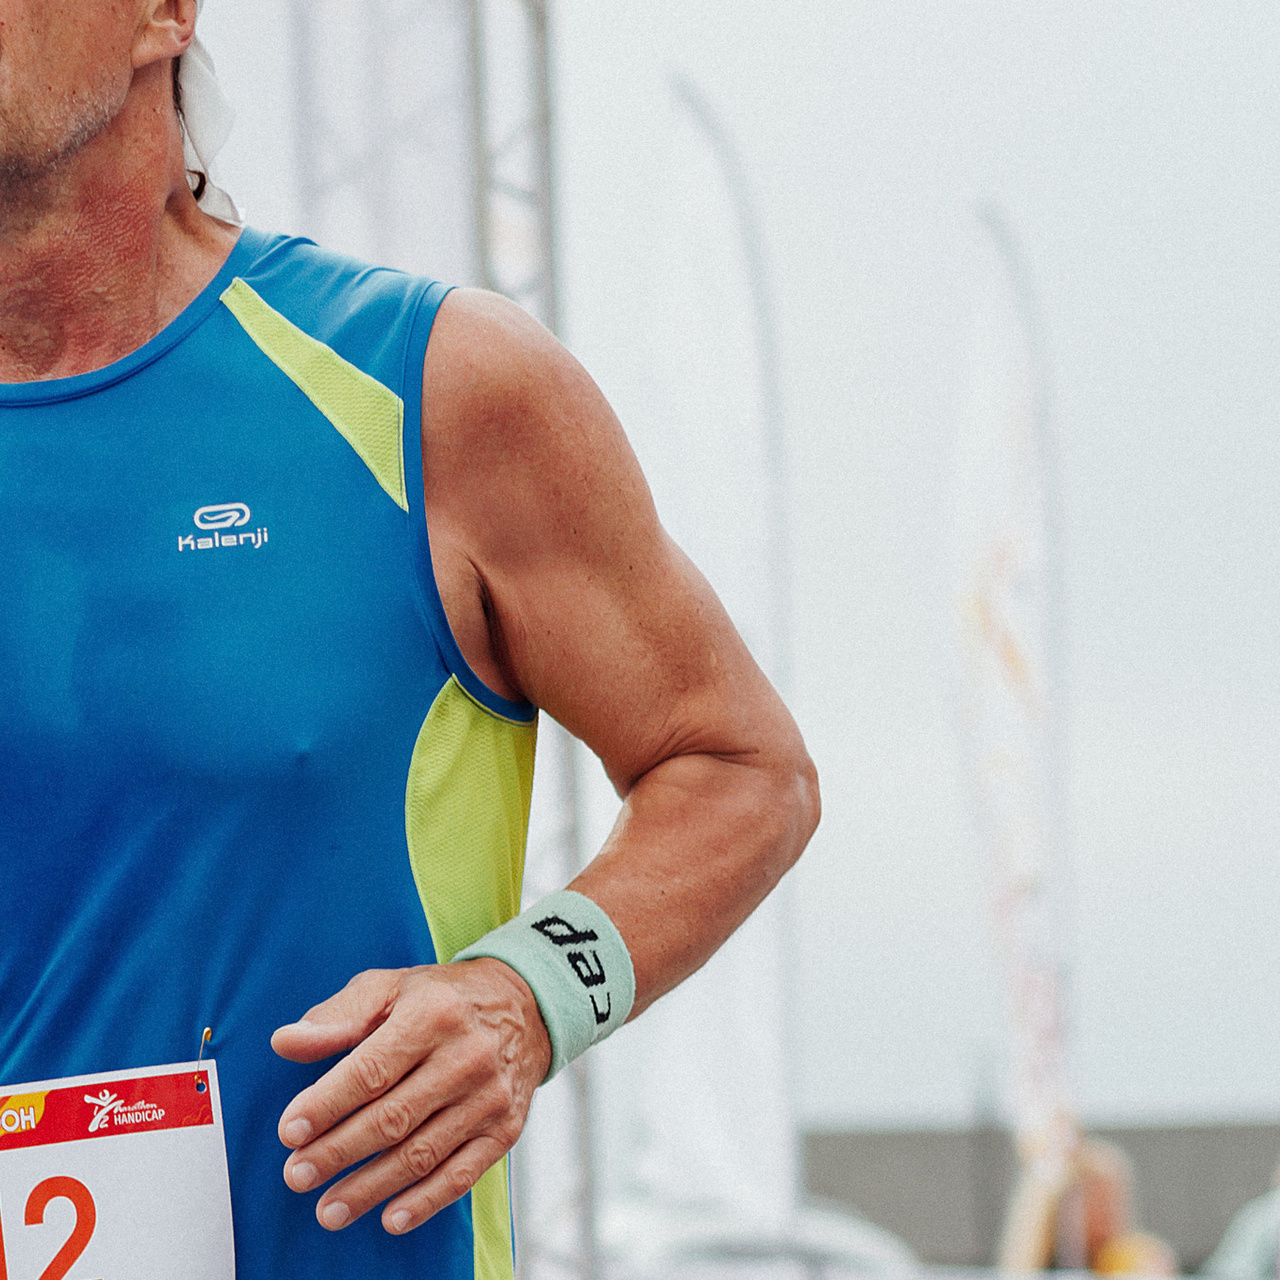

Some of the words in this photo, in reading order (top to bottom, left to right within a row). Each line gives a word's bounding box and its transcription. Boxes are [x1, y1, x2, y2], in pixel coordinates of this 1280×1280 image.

[177, 526, 269, 552] Kalenji
[531, 915, 612, 1025] cep
[113, 1108, 166, 1126] HANDICAP
